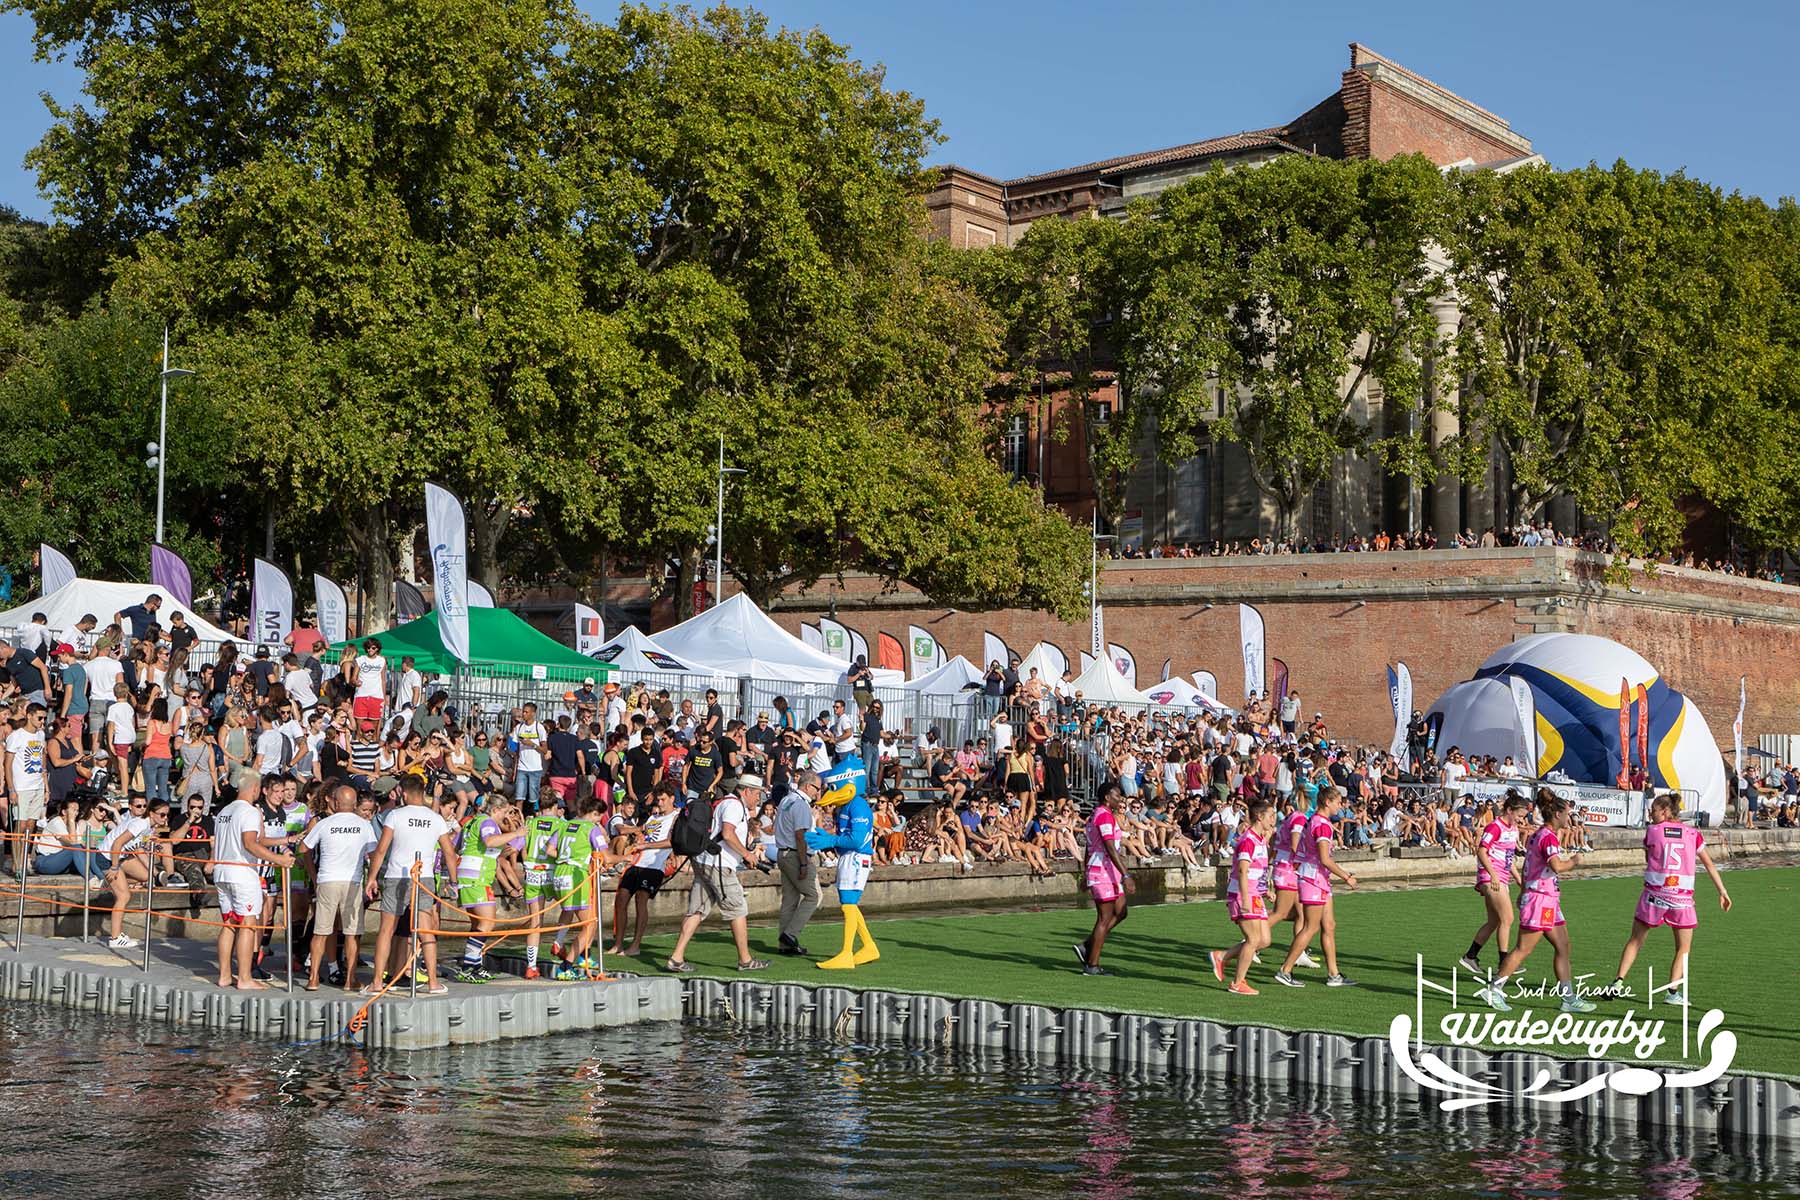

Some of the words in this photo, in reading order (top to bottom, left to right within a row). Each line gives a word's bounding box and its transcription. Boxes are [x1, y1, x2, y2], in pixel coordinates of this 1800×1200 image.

[1591, 805, 1623, 815] GRATUITES
[408, 818, 432, 828] STAFF
[330, 826, 361, 834] SPEAKER
[1663, 842, 1685, 870] 15
